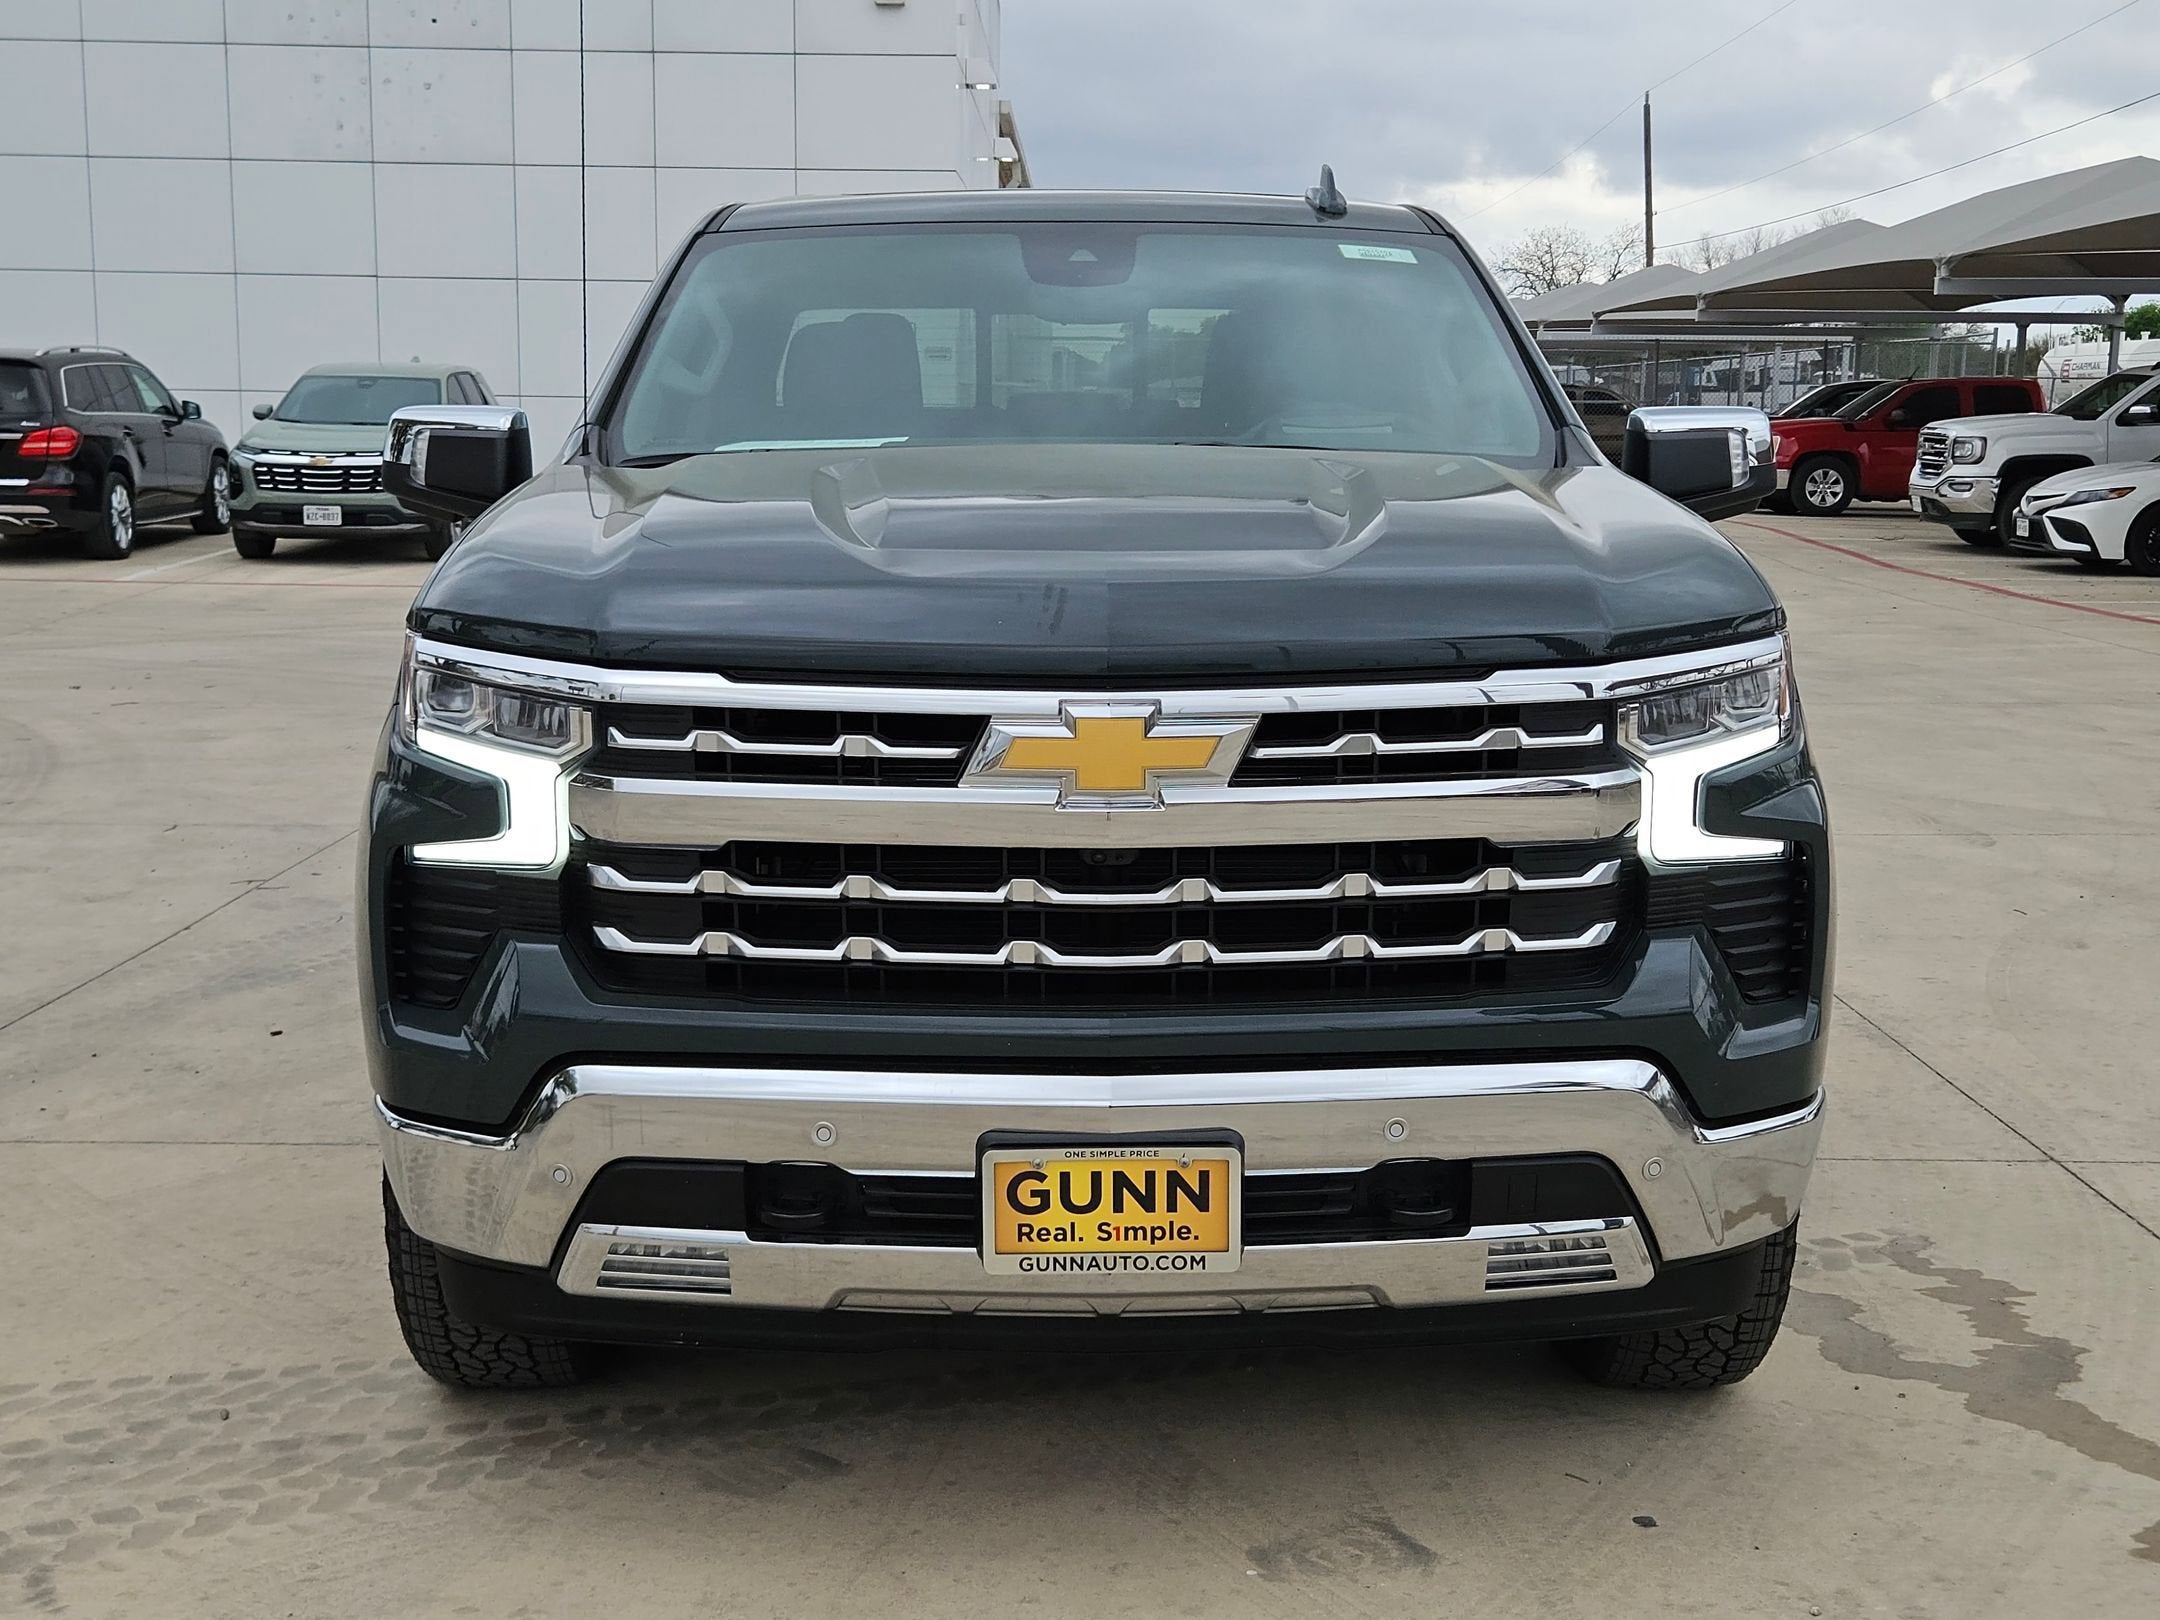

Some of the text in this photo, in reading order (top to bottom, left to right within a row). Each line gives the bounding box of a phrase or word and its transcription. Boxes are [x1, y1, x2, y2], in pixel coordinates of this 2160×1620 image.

[1064, 1149, 1160, 1159] ONE SIMPLE PRICE
[1006, 1169, 1210, 1216] GUNN
[1016, 1221, 1084, 1243] Real.
[1018, 1255, 1207, 1272] GUNNAUTO.COM
